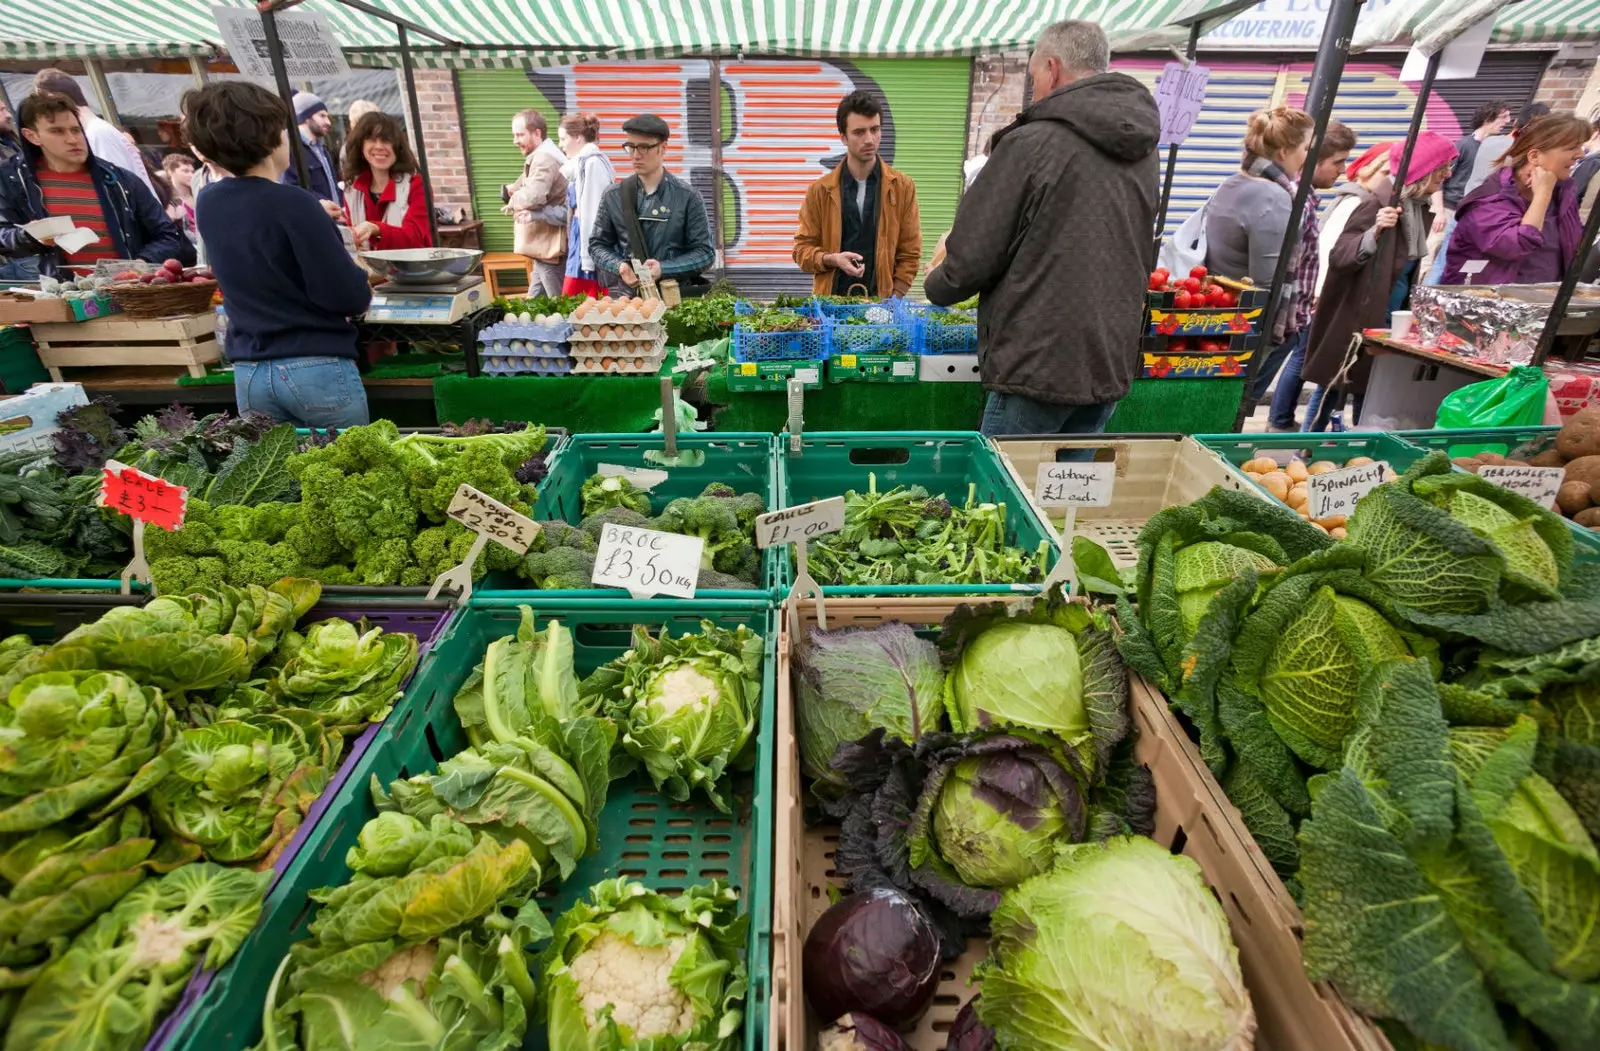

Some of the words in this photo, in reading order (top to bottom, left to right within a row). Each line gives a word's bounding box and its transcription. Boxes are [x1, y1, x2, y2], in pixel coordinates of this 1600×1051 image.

[1182, 312, 1224, 333] Enjoy
[1174, 355, 1216, 376] Enjoy
[1047, 467, 1102, 487] Cabbage
[607, 527, 663, 551] BROC
[600, 547, 673, 586] £3.50
